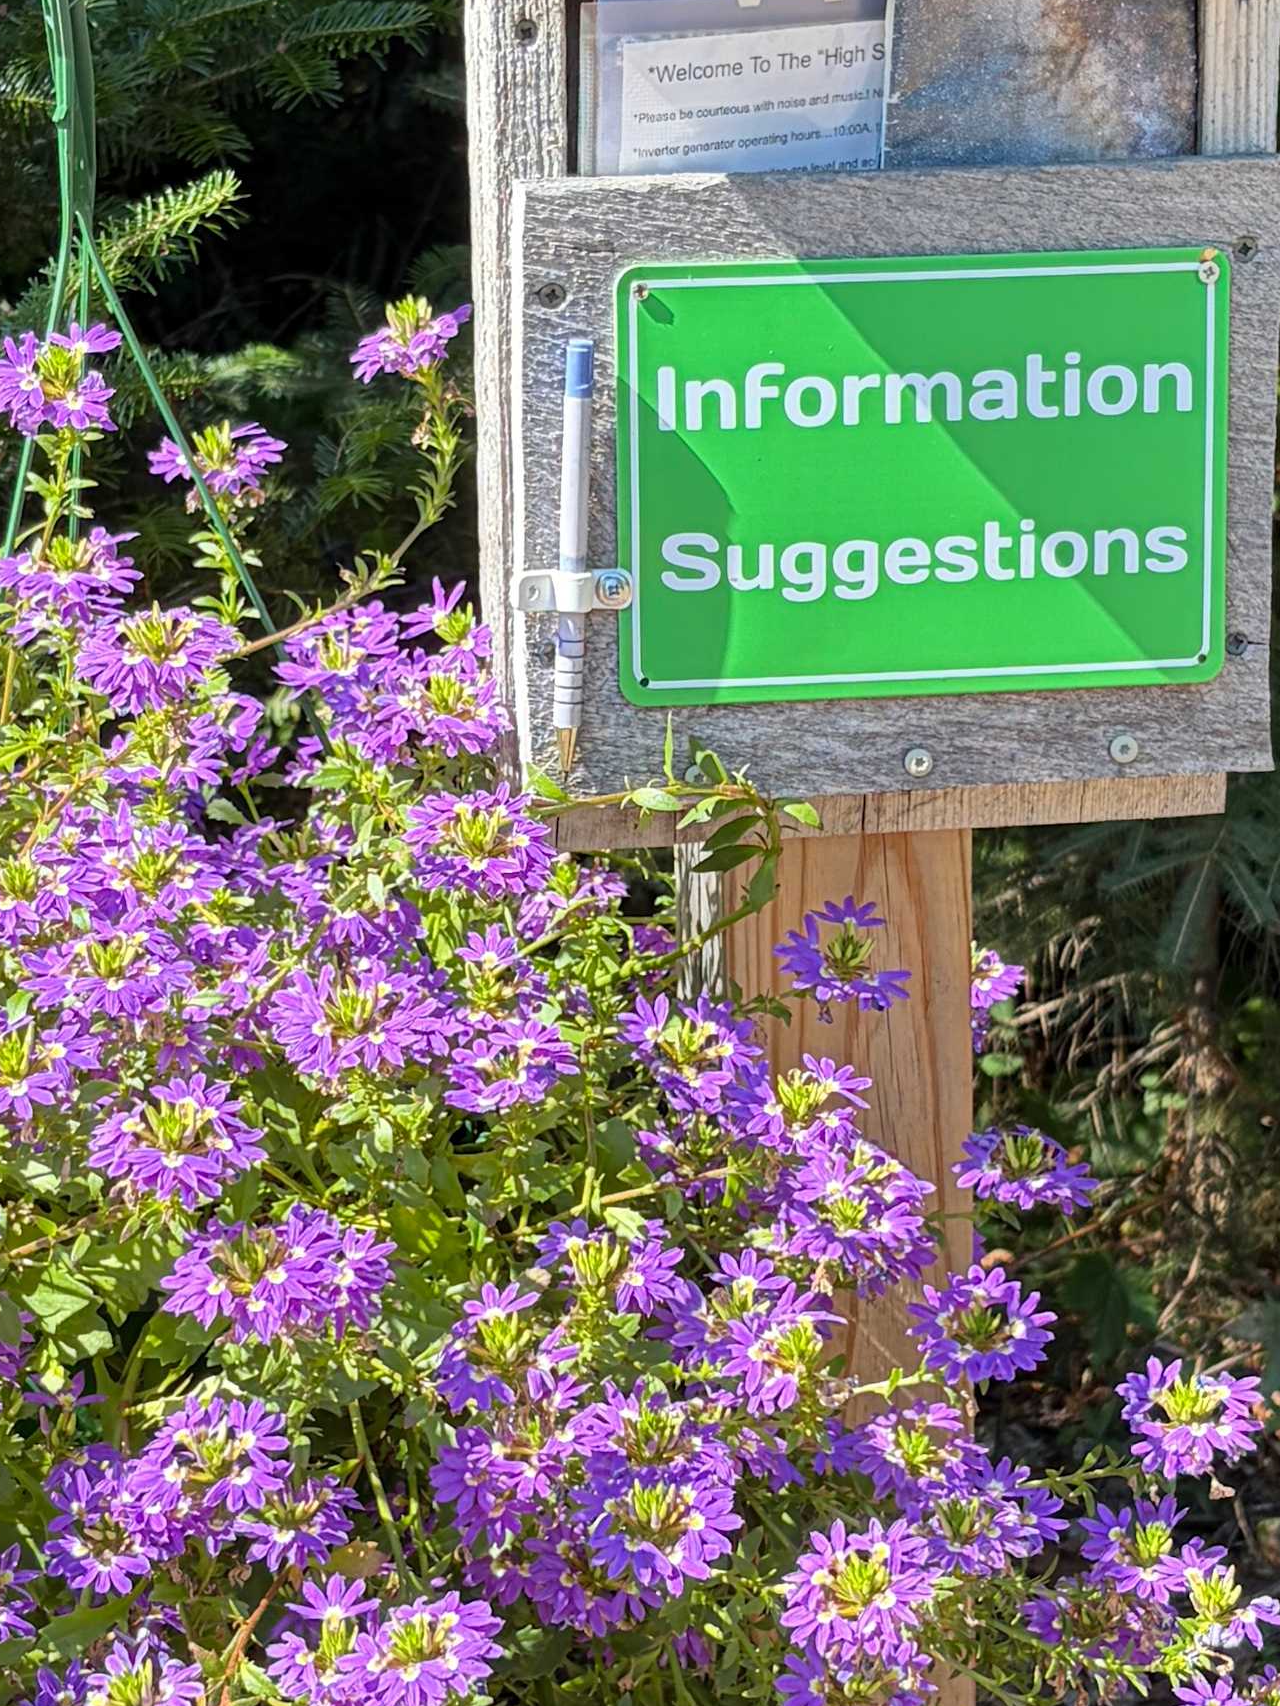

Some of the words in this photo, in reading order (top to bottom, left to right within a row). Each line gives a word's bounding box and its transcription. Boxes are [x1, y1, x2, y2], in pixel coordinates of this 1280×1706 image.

[749, 56, 771, 74] To
[777, 52, 812, 71] The
[679, 108, 693, 120] be
[695, 102, 750, 119] courteous
[753, 99, 775, 113] with
[777, 96, 807, 110] noise
[809, 92, 829, 107] and
[682, 138, 736, 156] generator
[737, 131, 787, 149] operating
[656, 351, 1194, 432] Information
[659, 518, 1189, 603] Suggestions
